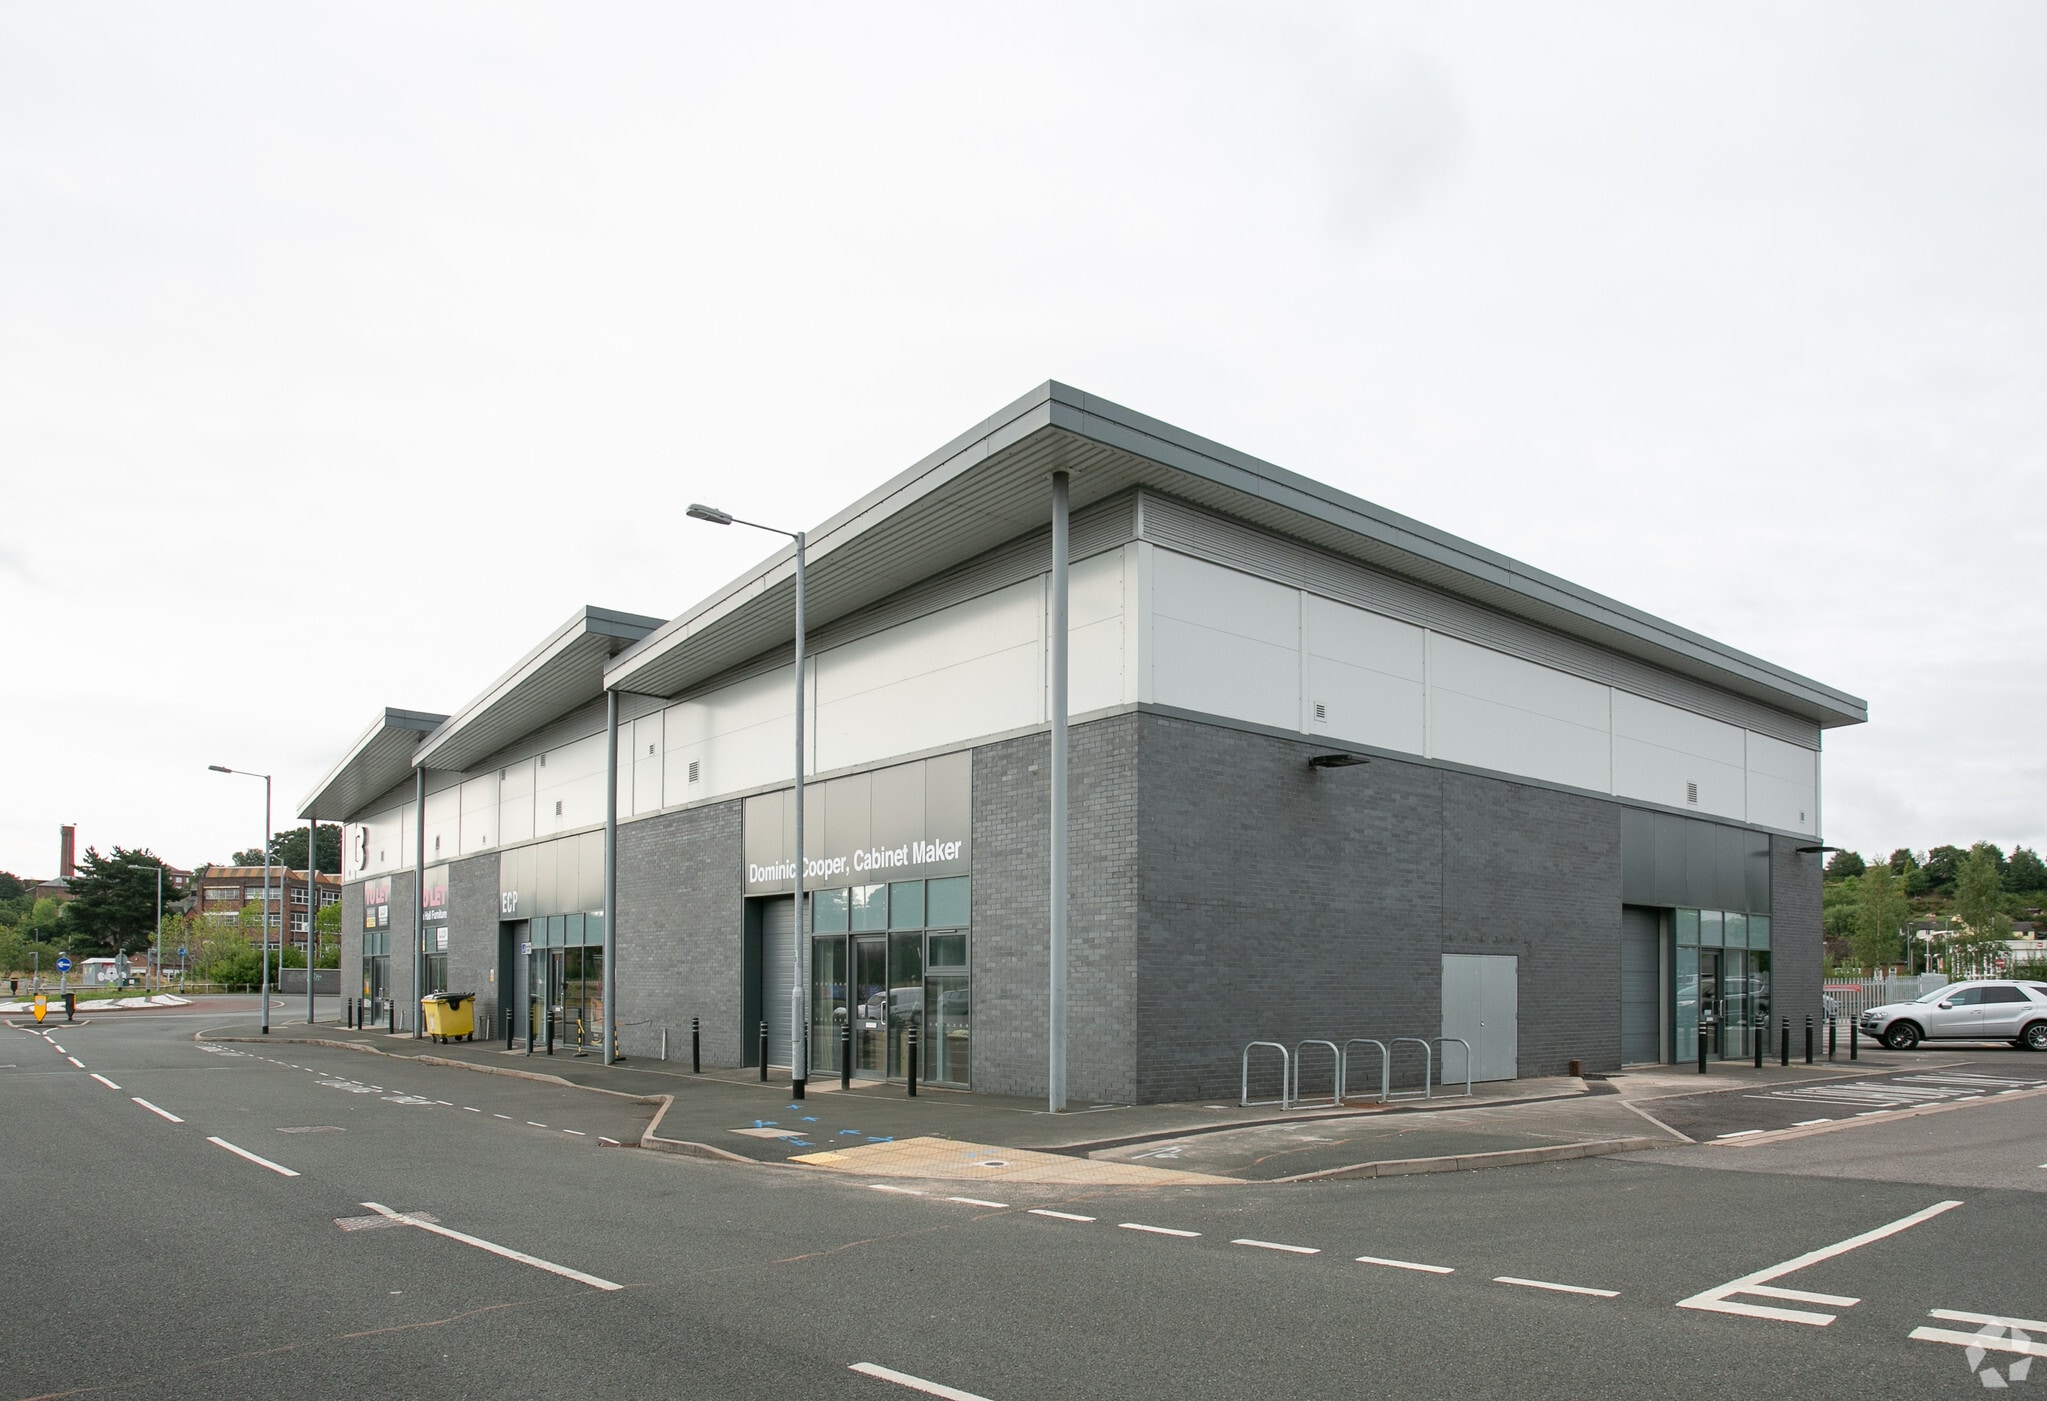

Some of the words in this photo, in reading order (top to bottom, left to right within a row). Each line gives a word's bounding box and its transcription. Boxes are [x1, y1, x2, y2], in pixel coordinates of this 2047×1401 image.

[749, 859, 797, 883] Dominic
[853, 845, 909, 872] Cabinet
[912, 838, 962, 864] Maker
[376, 886, 389, 904] LET
[430, 886, 446, 907] LET
[502, 890, 518, 913] ECP
